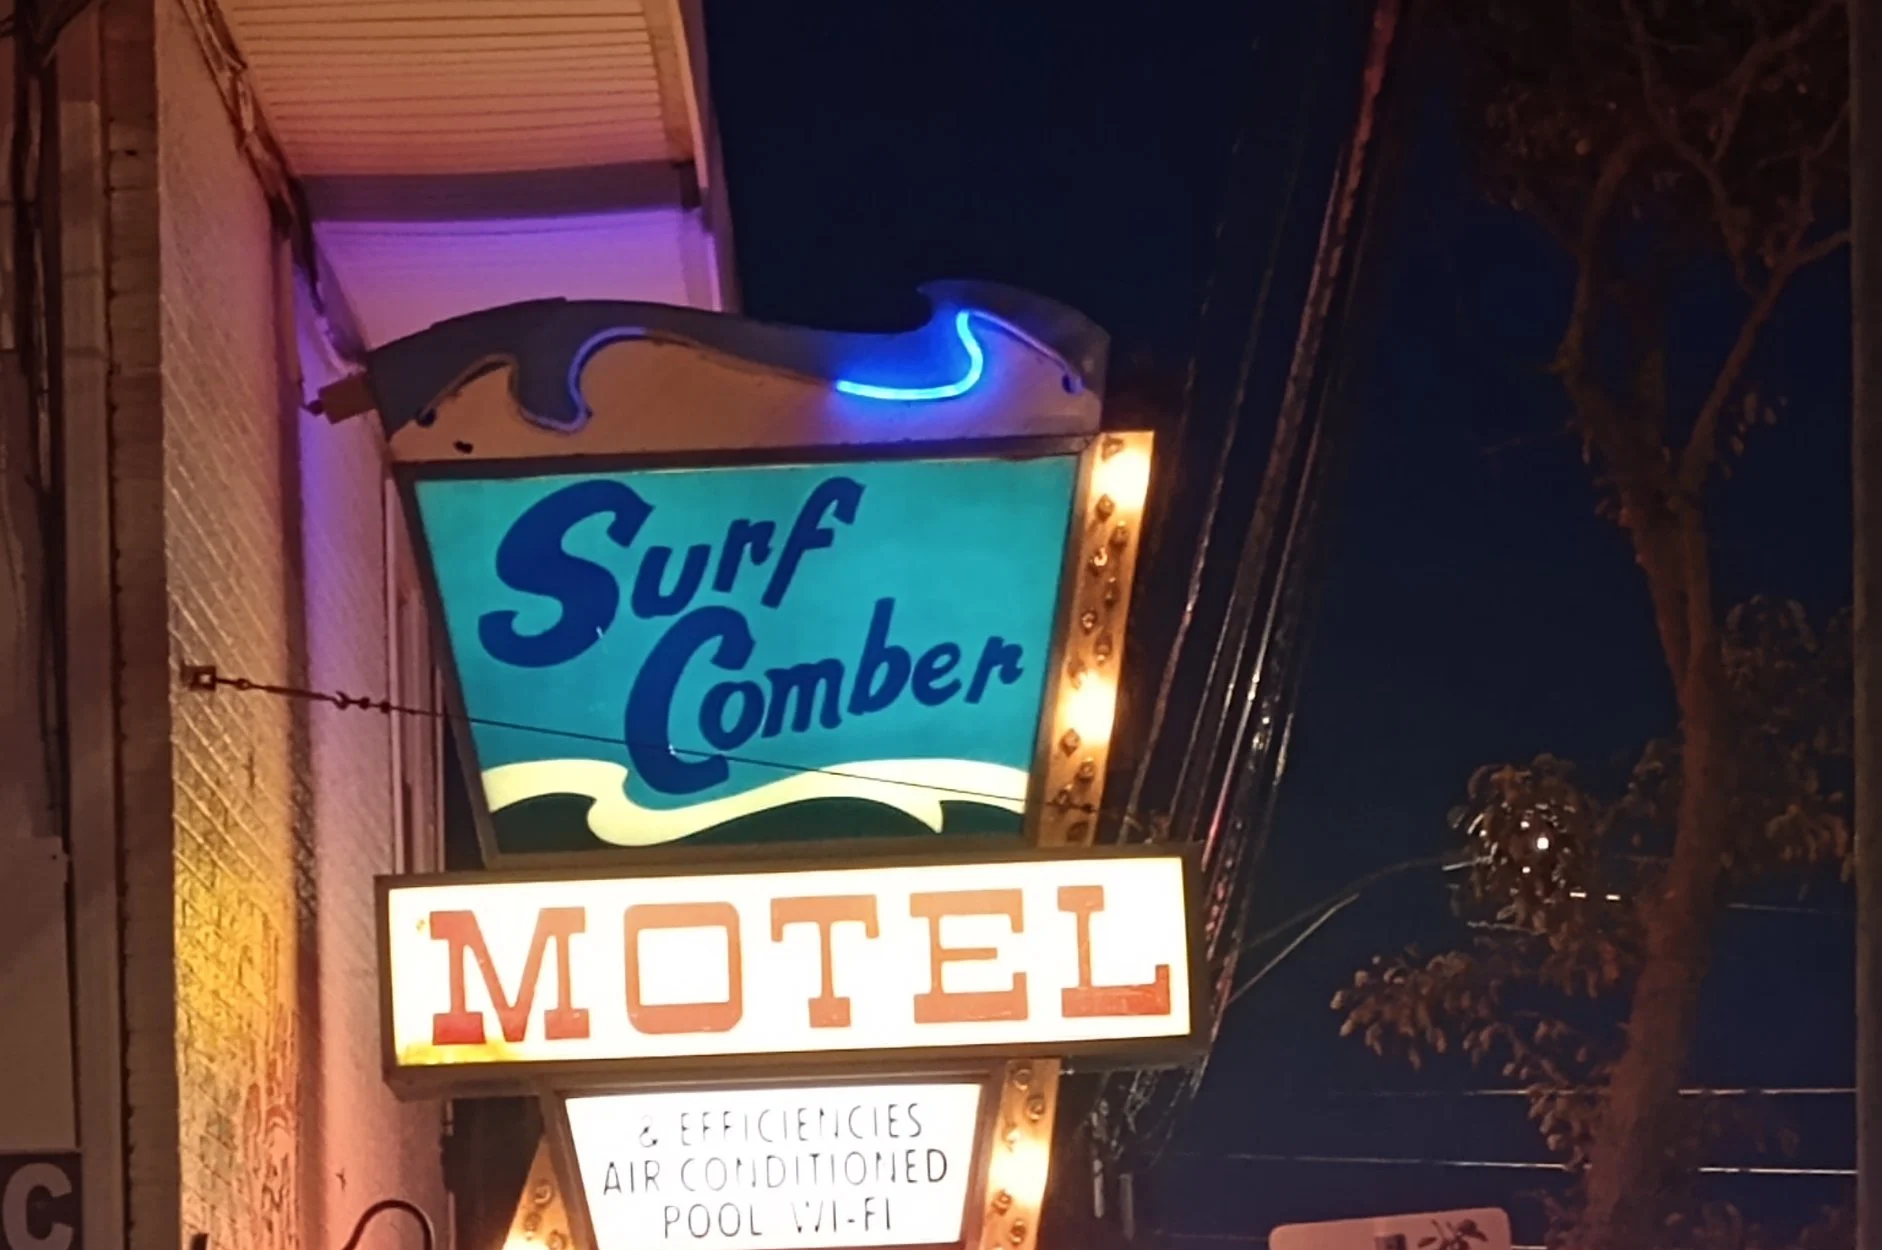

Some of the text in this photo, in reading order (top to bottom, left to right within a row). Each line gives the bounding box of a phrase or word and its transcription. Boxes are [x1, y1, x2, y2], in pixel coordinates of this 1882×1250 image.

[477, 475, 865, 669] Surf
[624, 597, 1024, 795] Comber
[429, 884, 1172, 1045] MOTEL
[603, 1148, 949, 1197] AIR CONDITIONED
[638, 1103, 923, 1148] & EFFICIENCIES
[664, 1196, 892, 1240] POOL WI-FI
